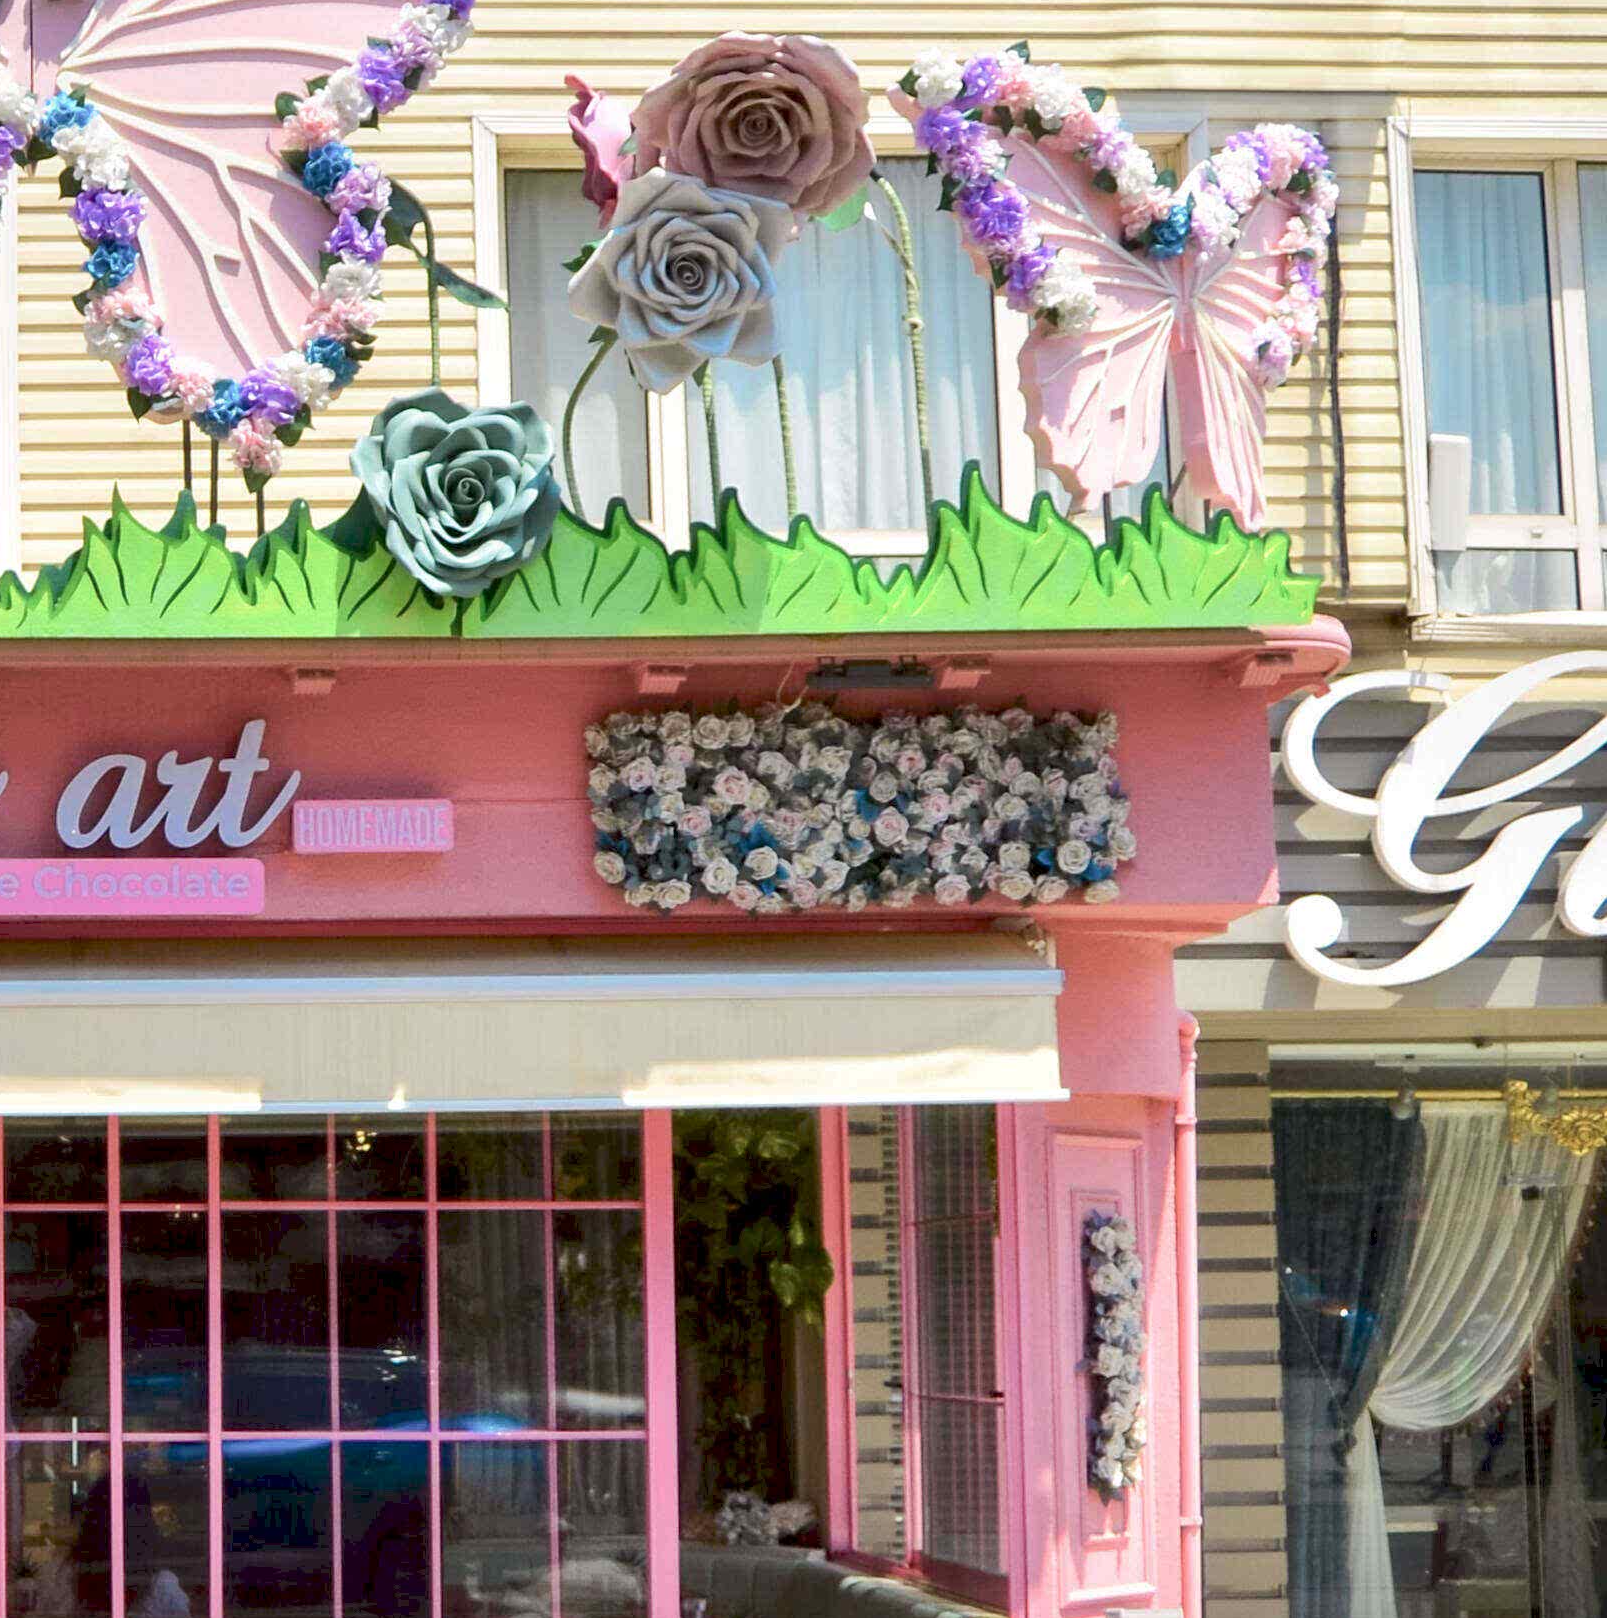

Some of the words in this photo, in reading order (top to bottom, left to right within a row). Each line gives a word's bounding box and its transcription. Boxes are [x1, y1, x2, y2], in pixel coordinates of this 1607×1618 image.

[56, 719, 301, 849] art
[297, 805, 450, 847] HOMEMADE
[1282, 649, 1607, 986] G
[33, 863, 251, 900] Chocolate
